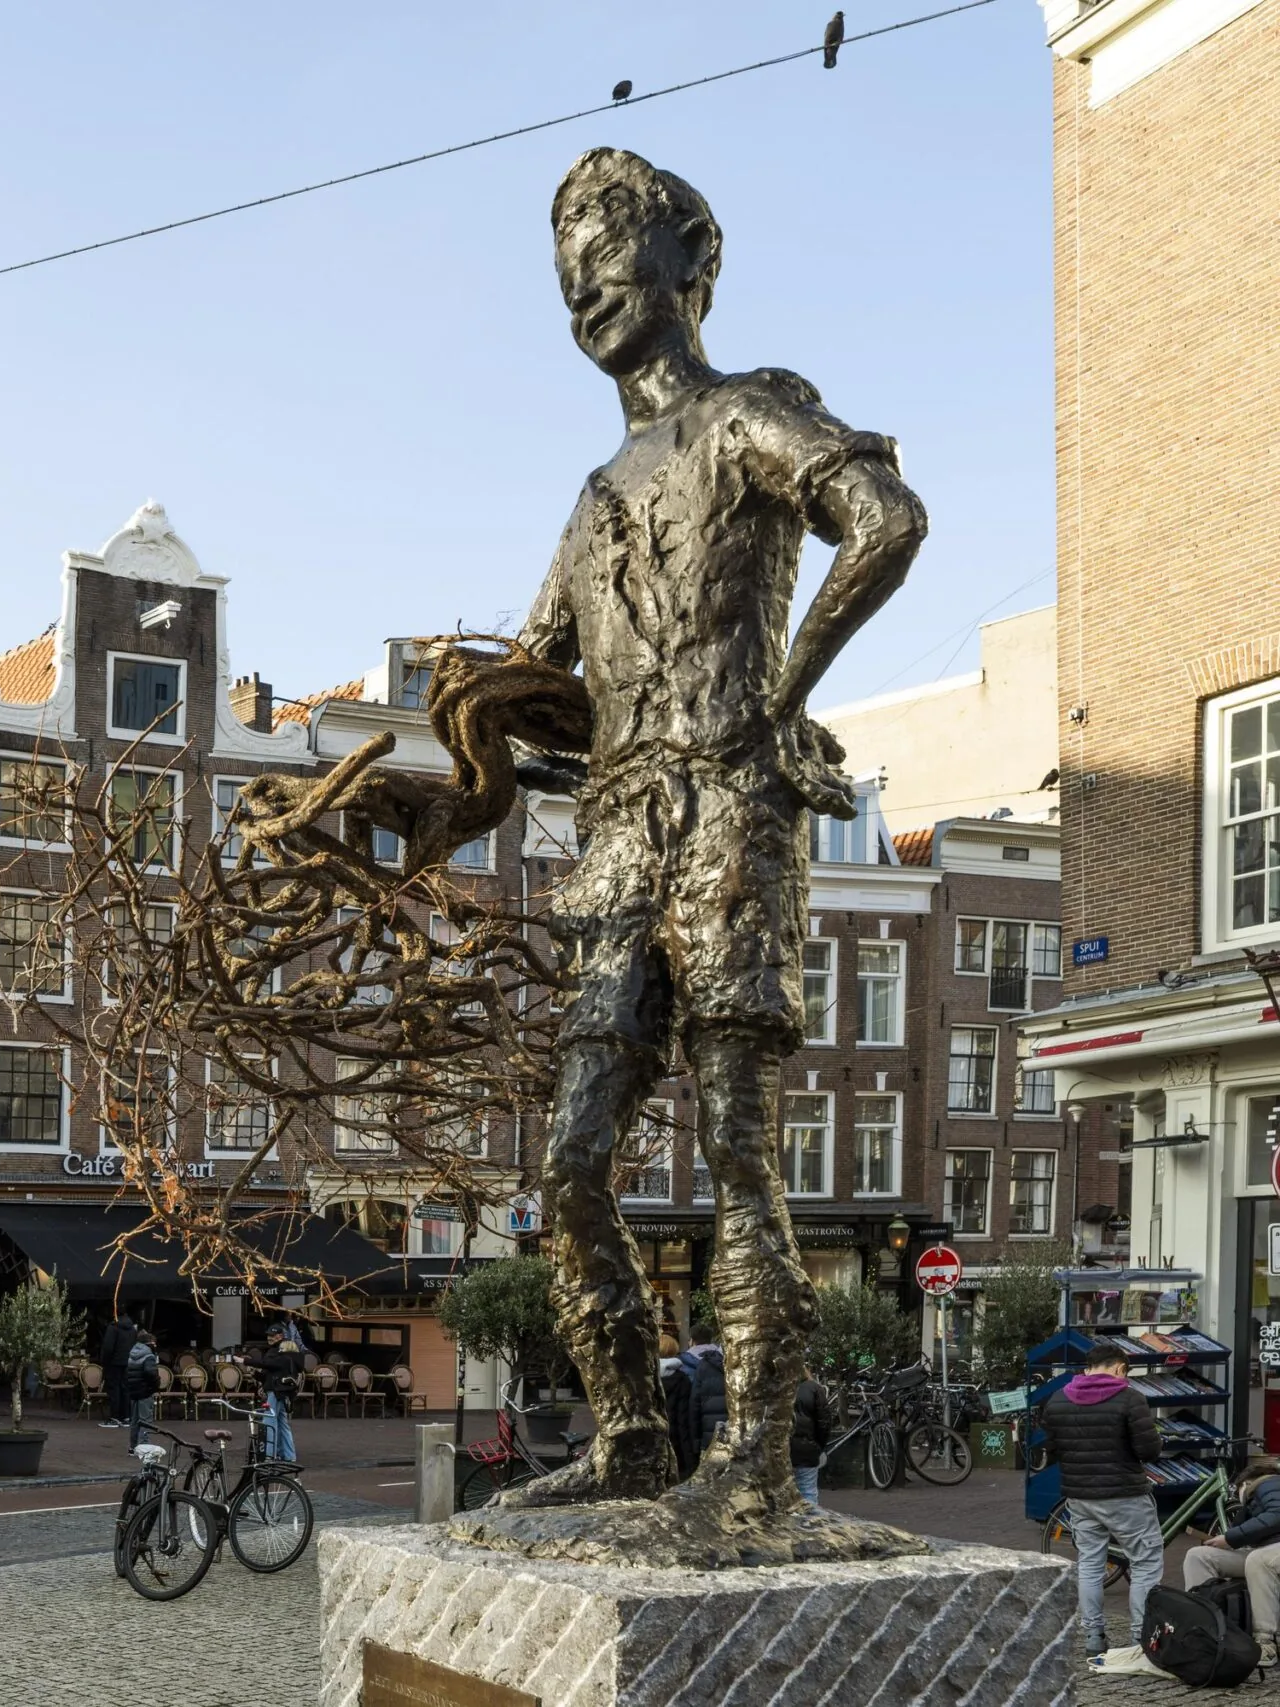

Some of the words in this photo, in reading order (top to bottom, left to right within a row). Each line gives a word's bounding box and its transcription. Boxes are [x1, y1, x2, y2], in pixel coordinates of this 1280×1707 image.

[1079, 941, 1100, 954] SPUI
[1076, 951, 1104, 963] CENTRUM
[63, 1153, 115, 1176] Café
[797, 1227, 855, 1236] GASTROVINO
[215, 1285, 238, 1296] Café
[238, 1285, 250, 1296] de
